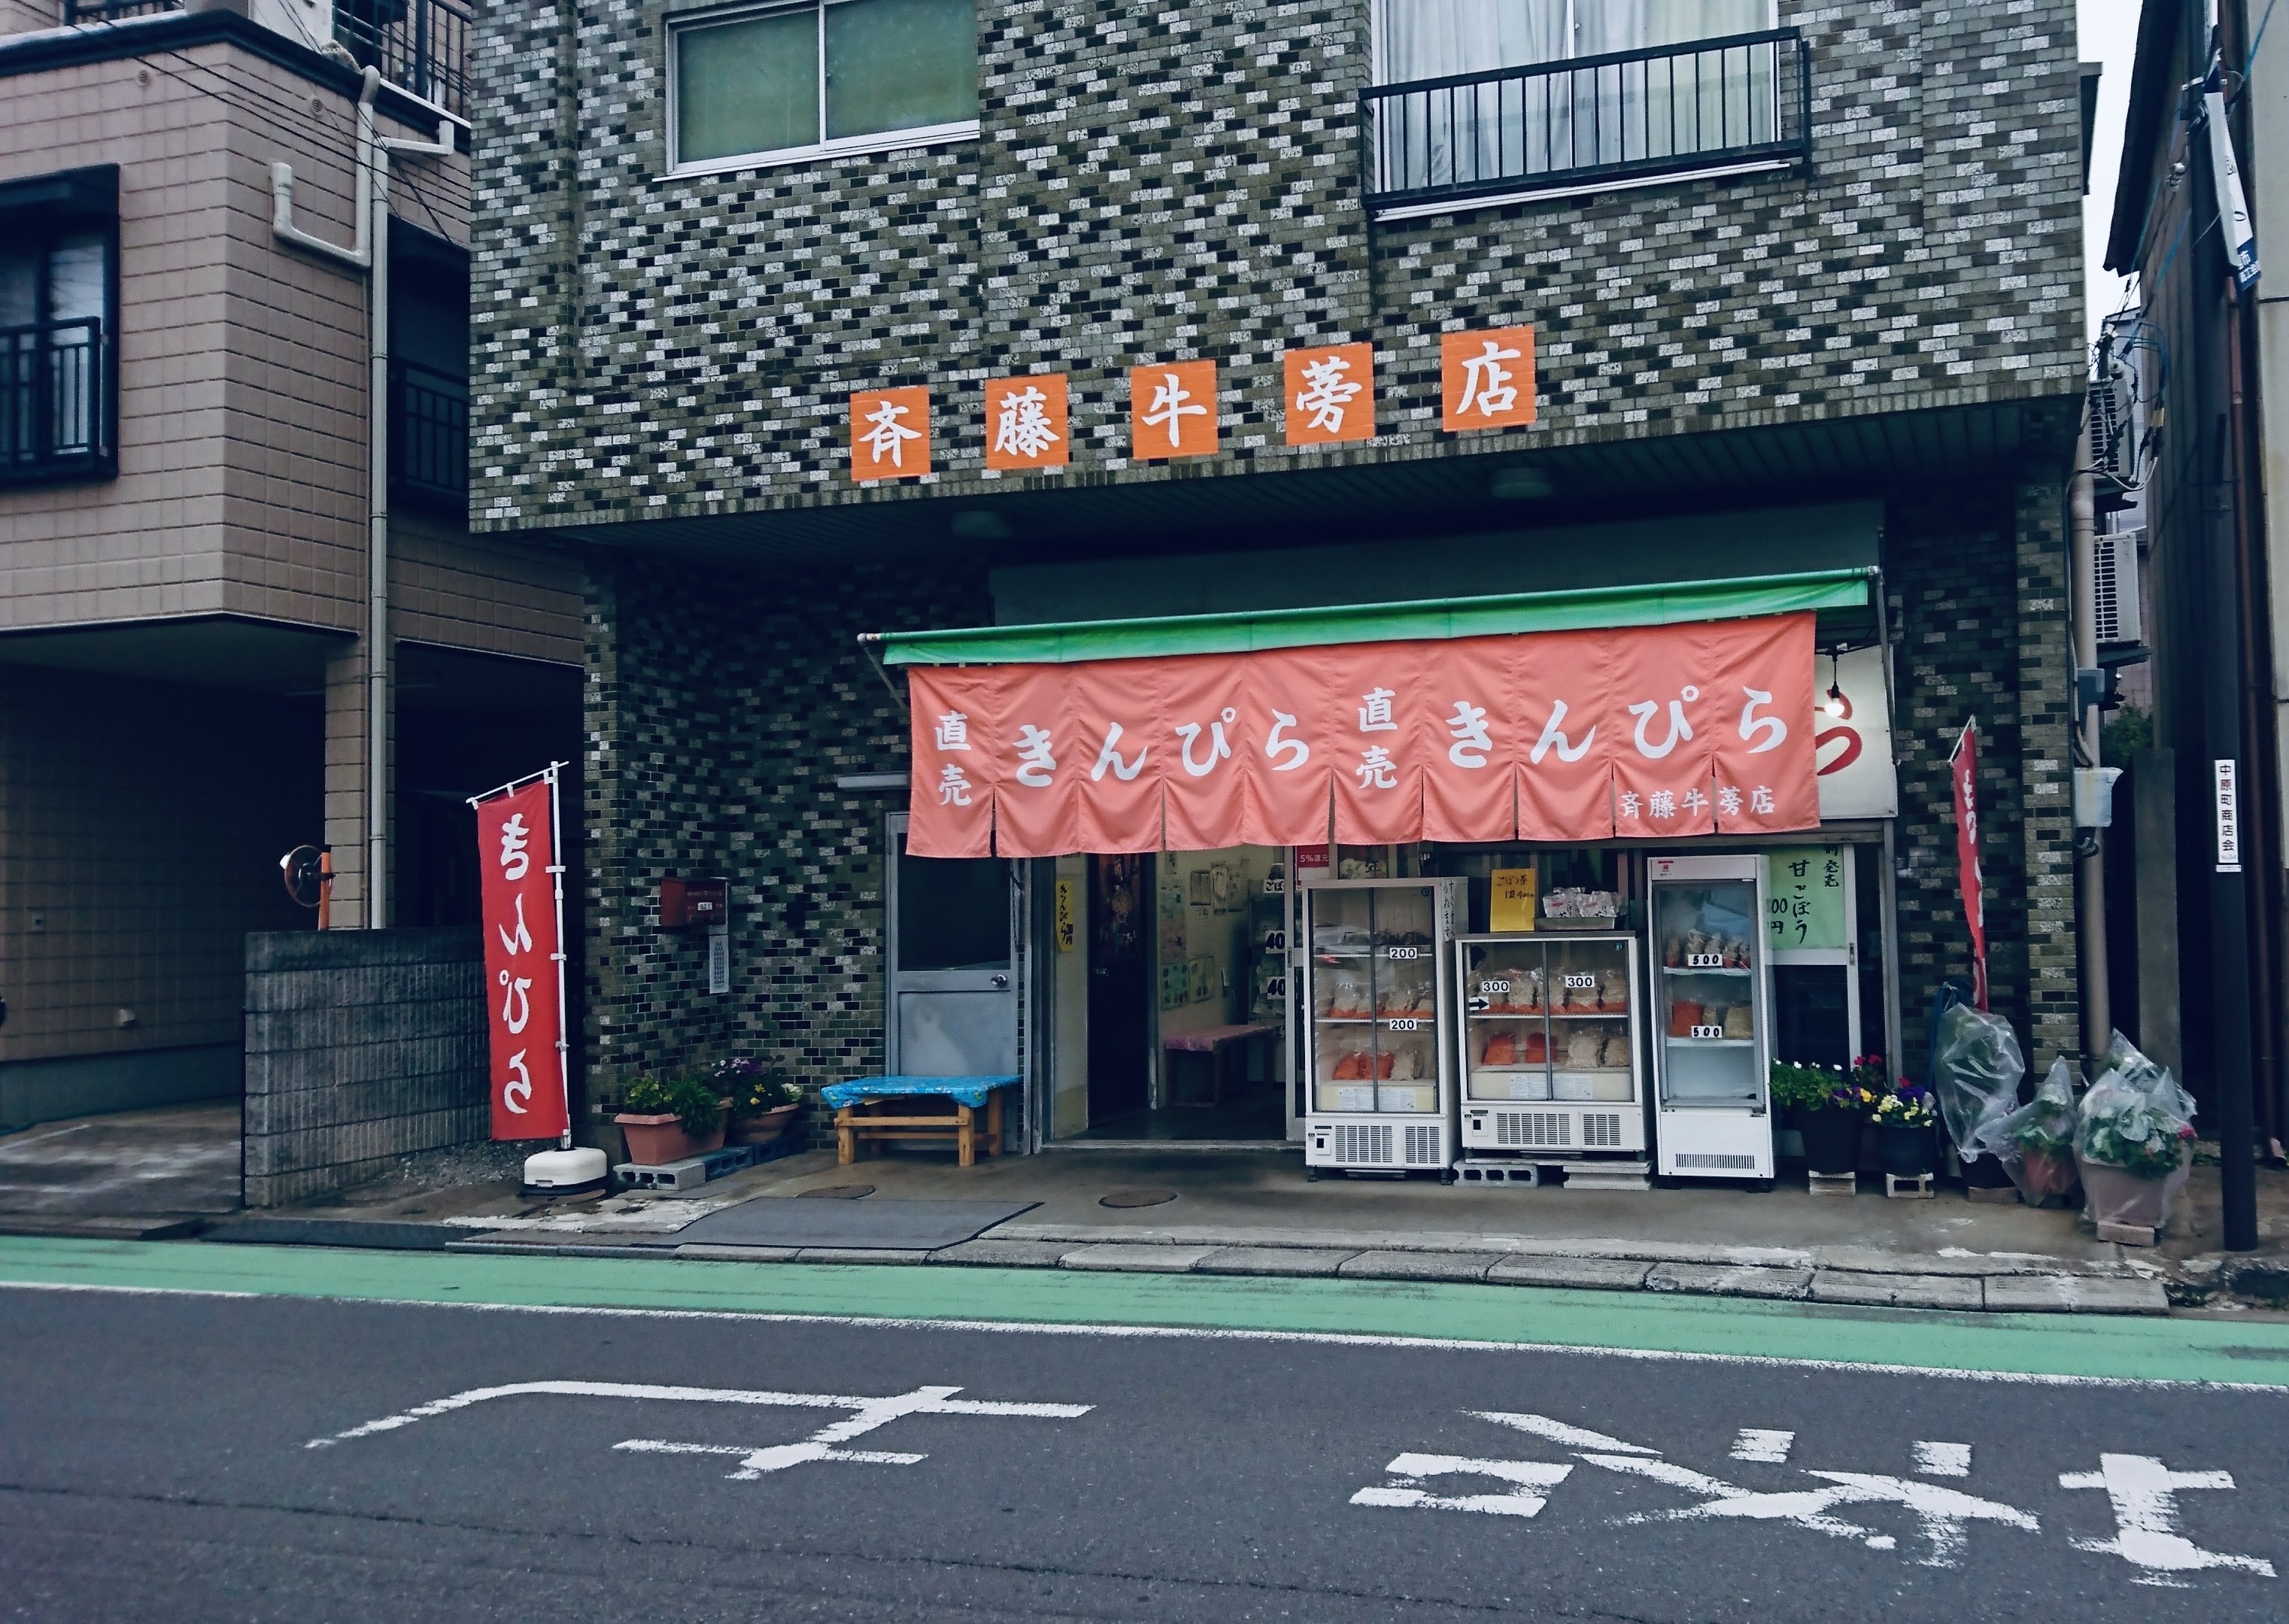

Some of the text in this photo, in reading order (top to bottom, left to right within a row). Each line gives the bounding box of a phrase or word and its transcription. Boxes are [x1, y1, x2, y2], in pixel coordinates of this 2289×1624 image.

[859, 341, 1520, 468] 斉藤牛蒡店
[1012, 706, 1310, 788] きんぴら
[1356, 687, 1398, 789] 直売
[1446, 685, 1787, 768] きんぴら
[934, 710, 972, 806] 直売
[1620, 785, 1774, 819] 斉藤牛蒡店
[2220, 764, 2234, 851] 中原町商店会
[1788, 859, 1811, 945] 甘ごぼう
[1391, 949, 1415, 958] 200
[1568, 977, 1592, 987] 300
[1692, 955, 1719, 964] 500
[1483, 982, 1508, 991] 300
[1391, 1019, 1414, 1029] 200
[1693, 1027, 1720, 1037] 500
